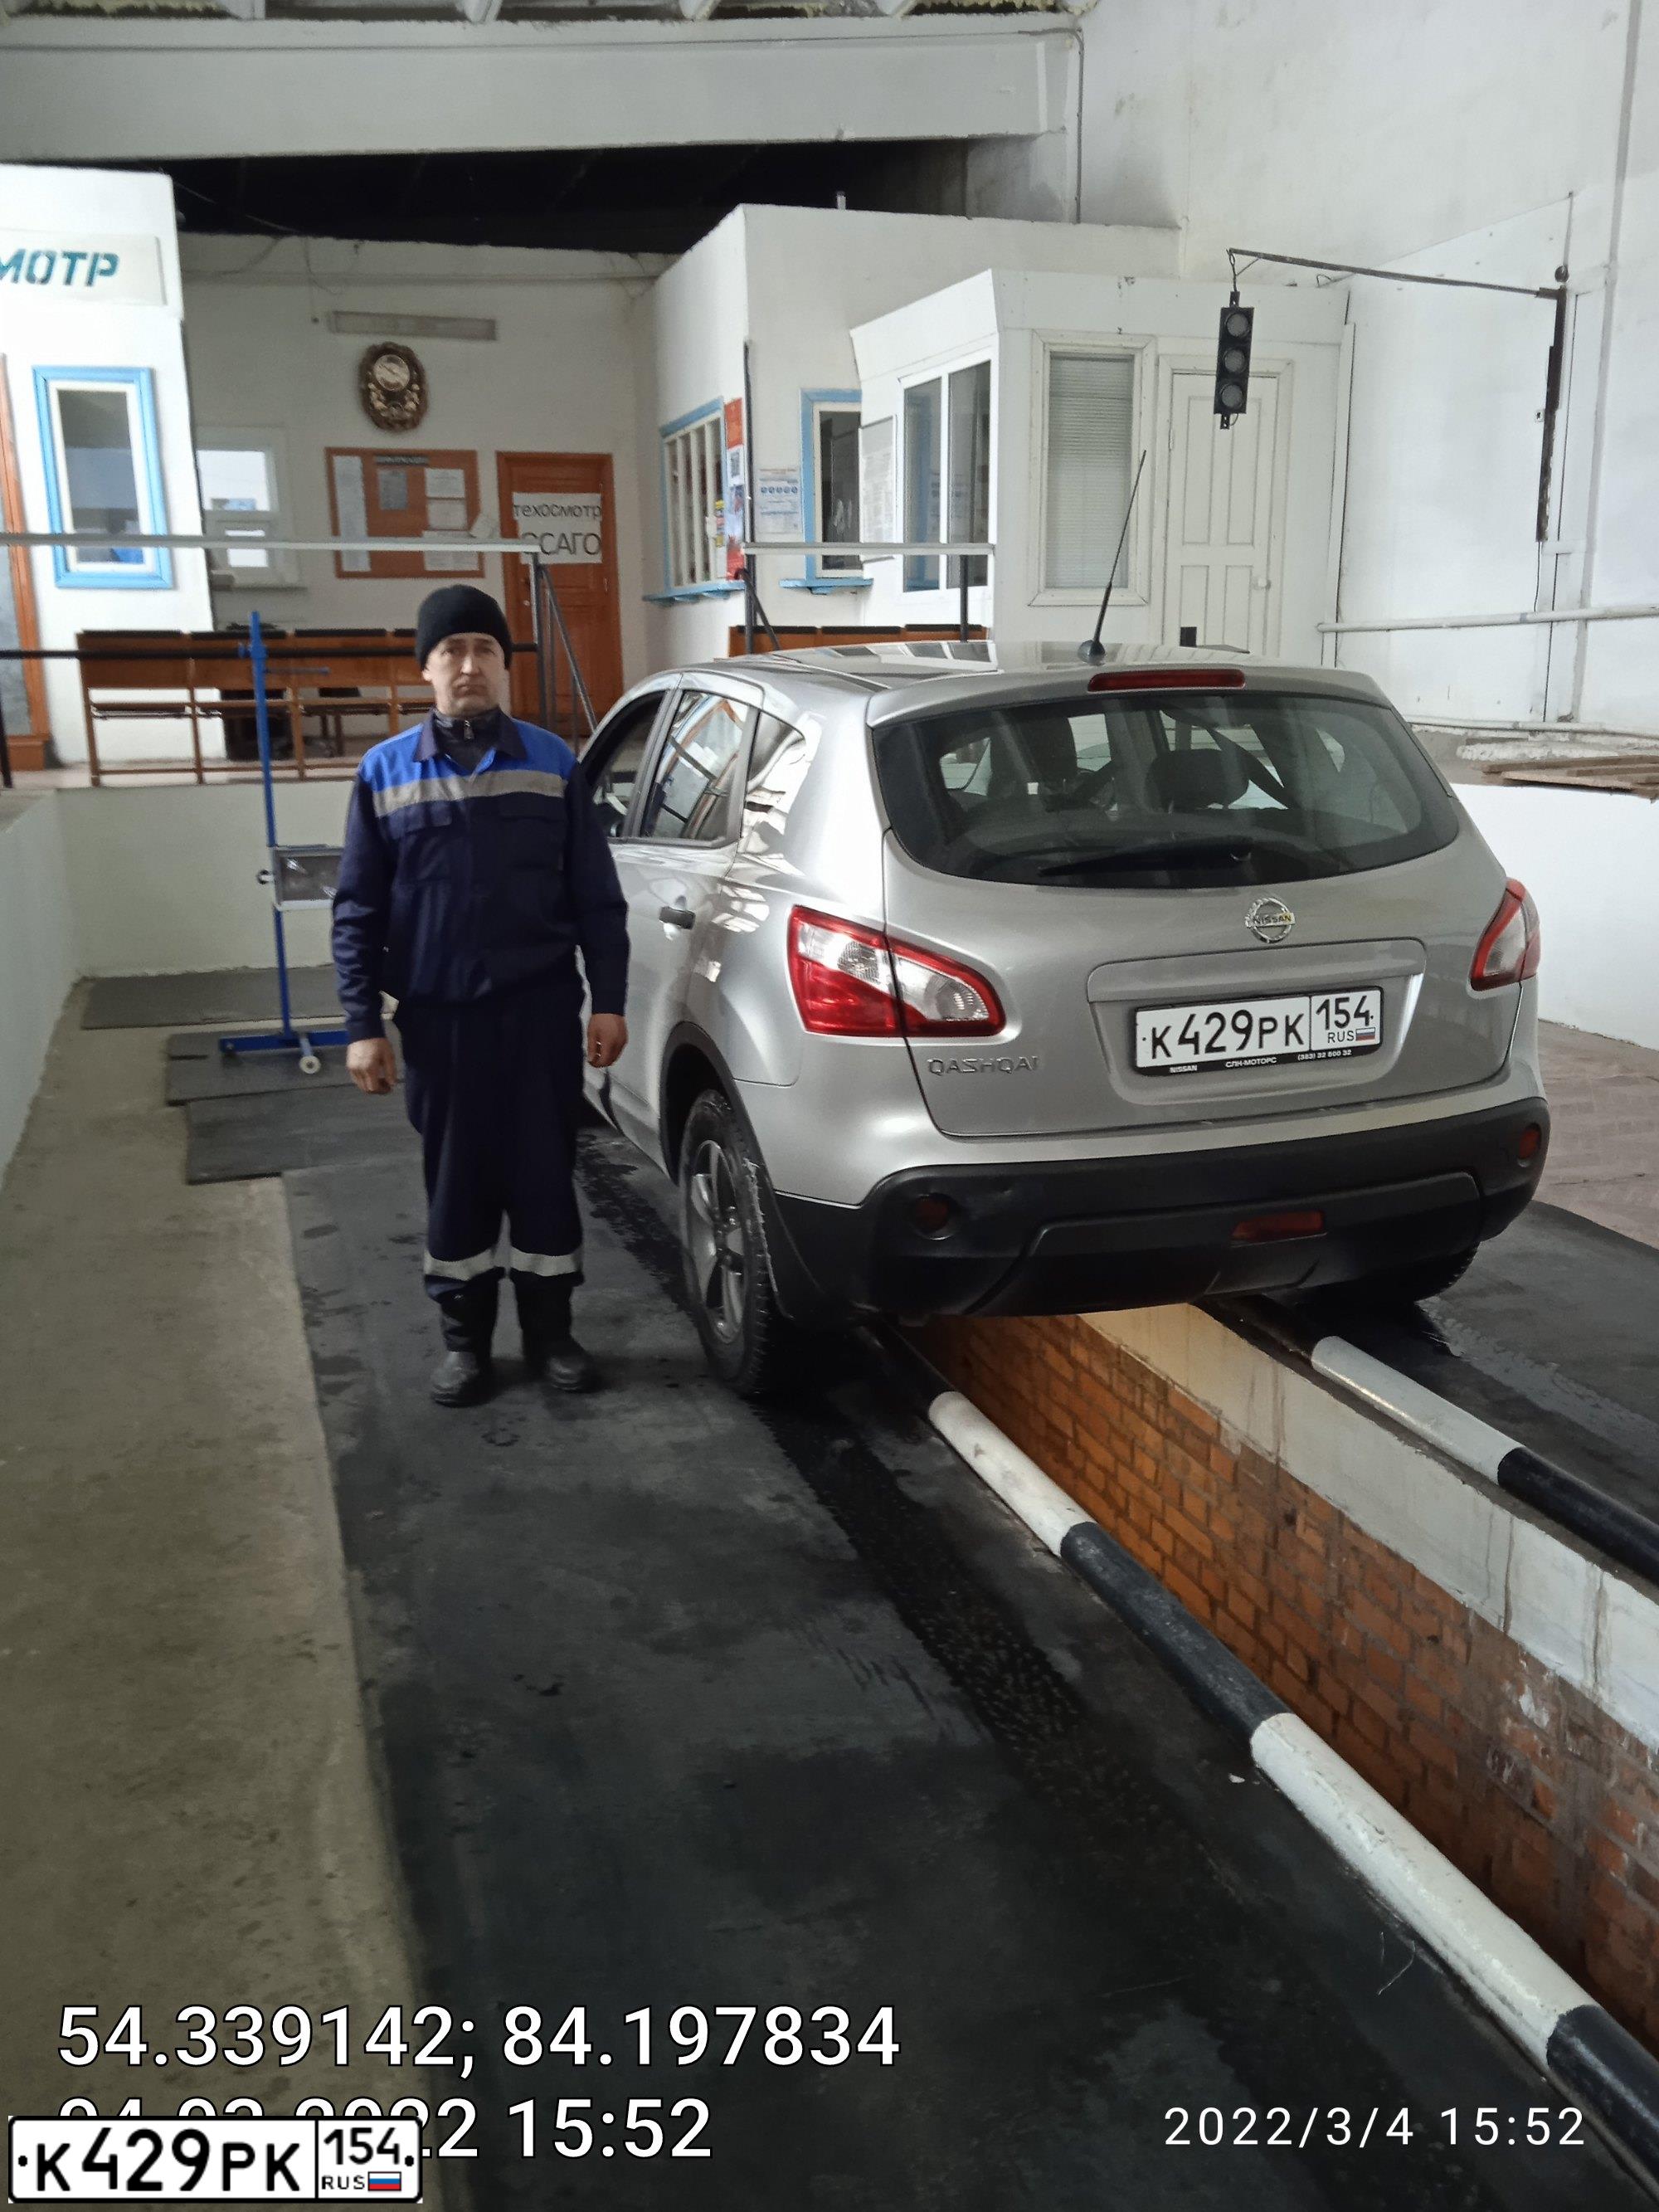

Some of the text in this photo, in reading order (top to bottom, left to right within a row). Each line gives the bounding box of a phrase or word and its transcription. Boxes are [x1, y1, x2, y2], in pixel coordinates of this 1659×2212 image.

[1253, 914, 1292, 925] NISSAN
[1316, 995, 1370, 1031] 154
[1327, 1030, 1355, 1044] RUS
[927, 1055, 1038, 1076] QASHQAI
[1169, 1064, 1198, 1074] NISSAN
